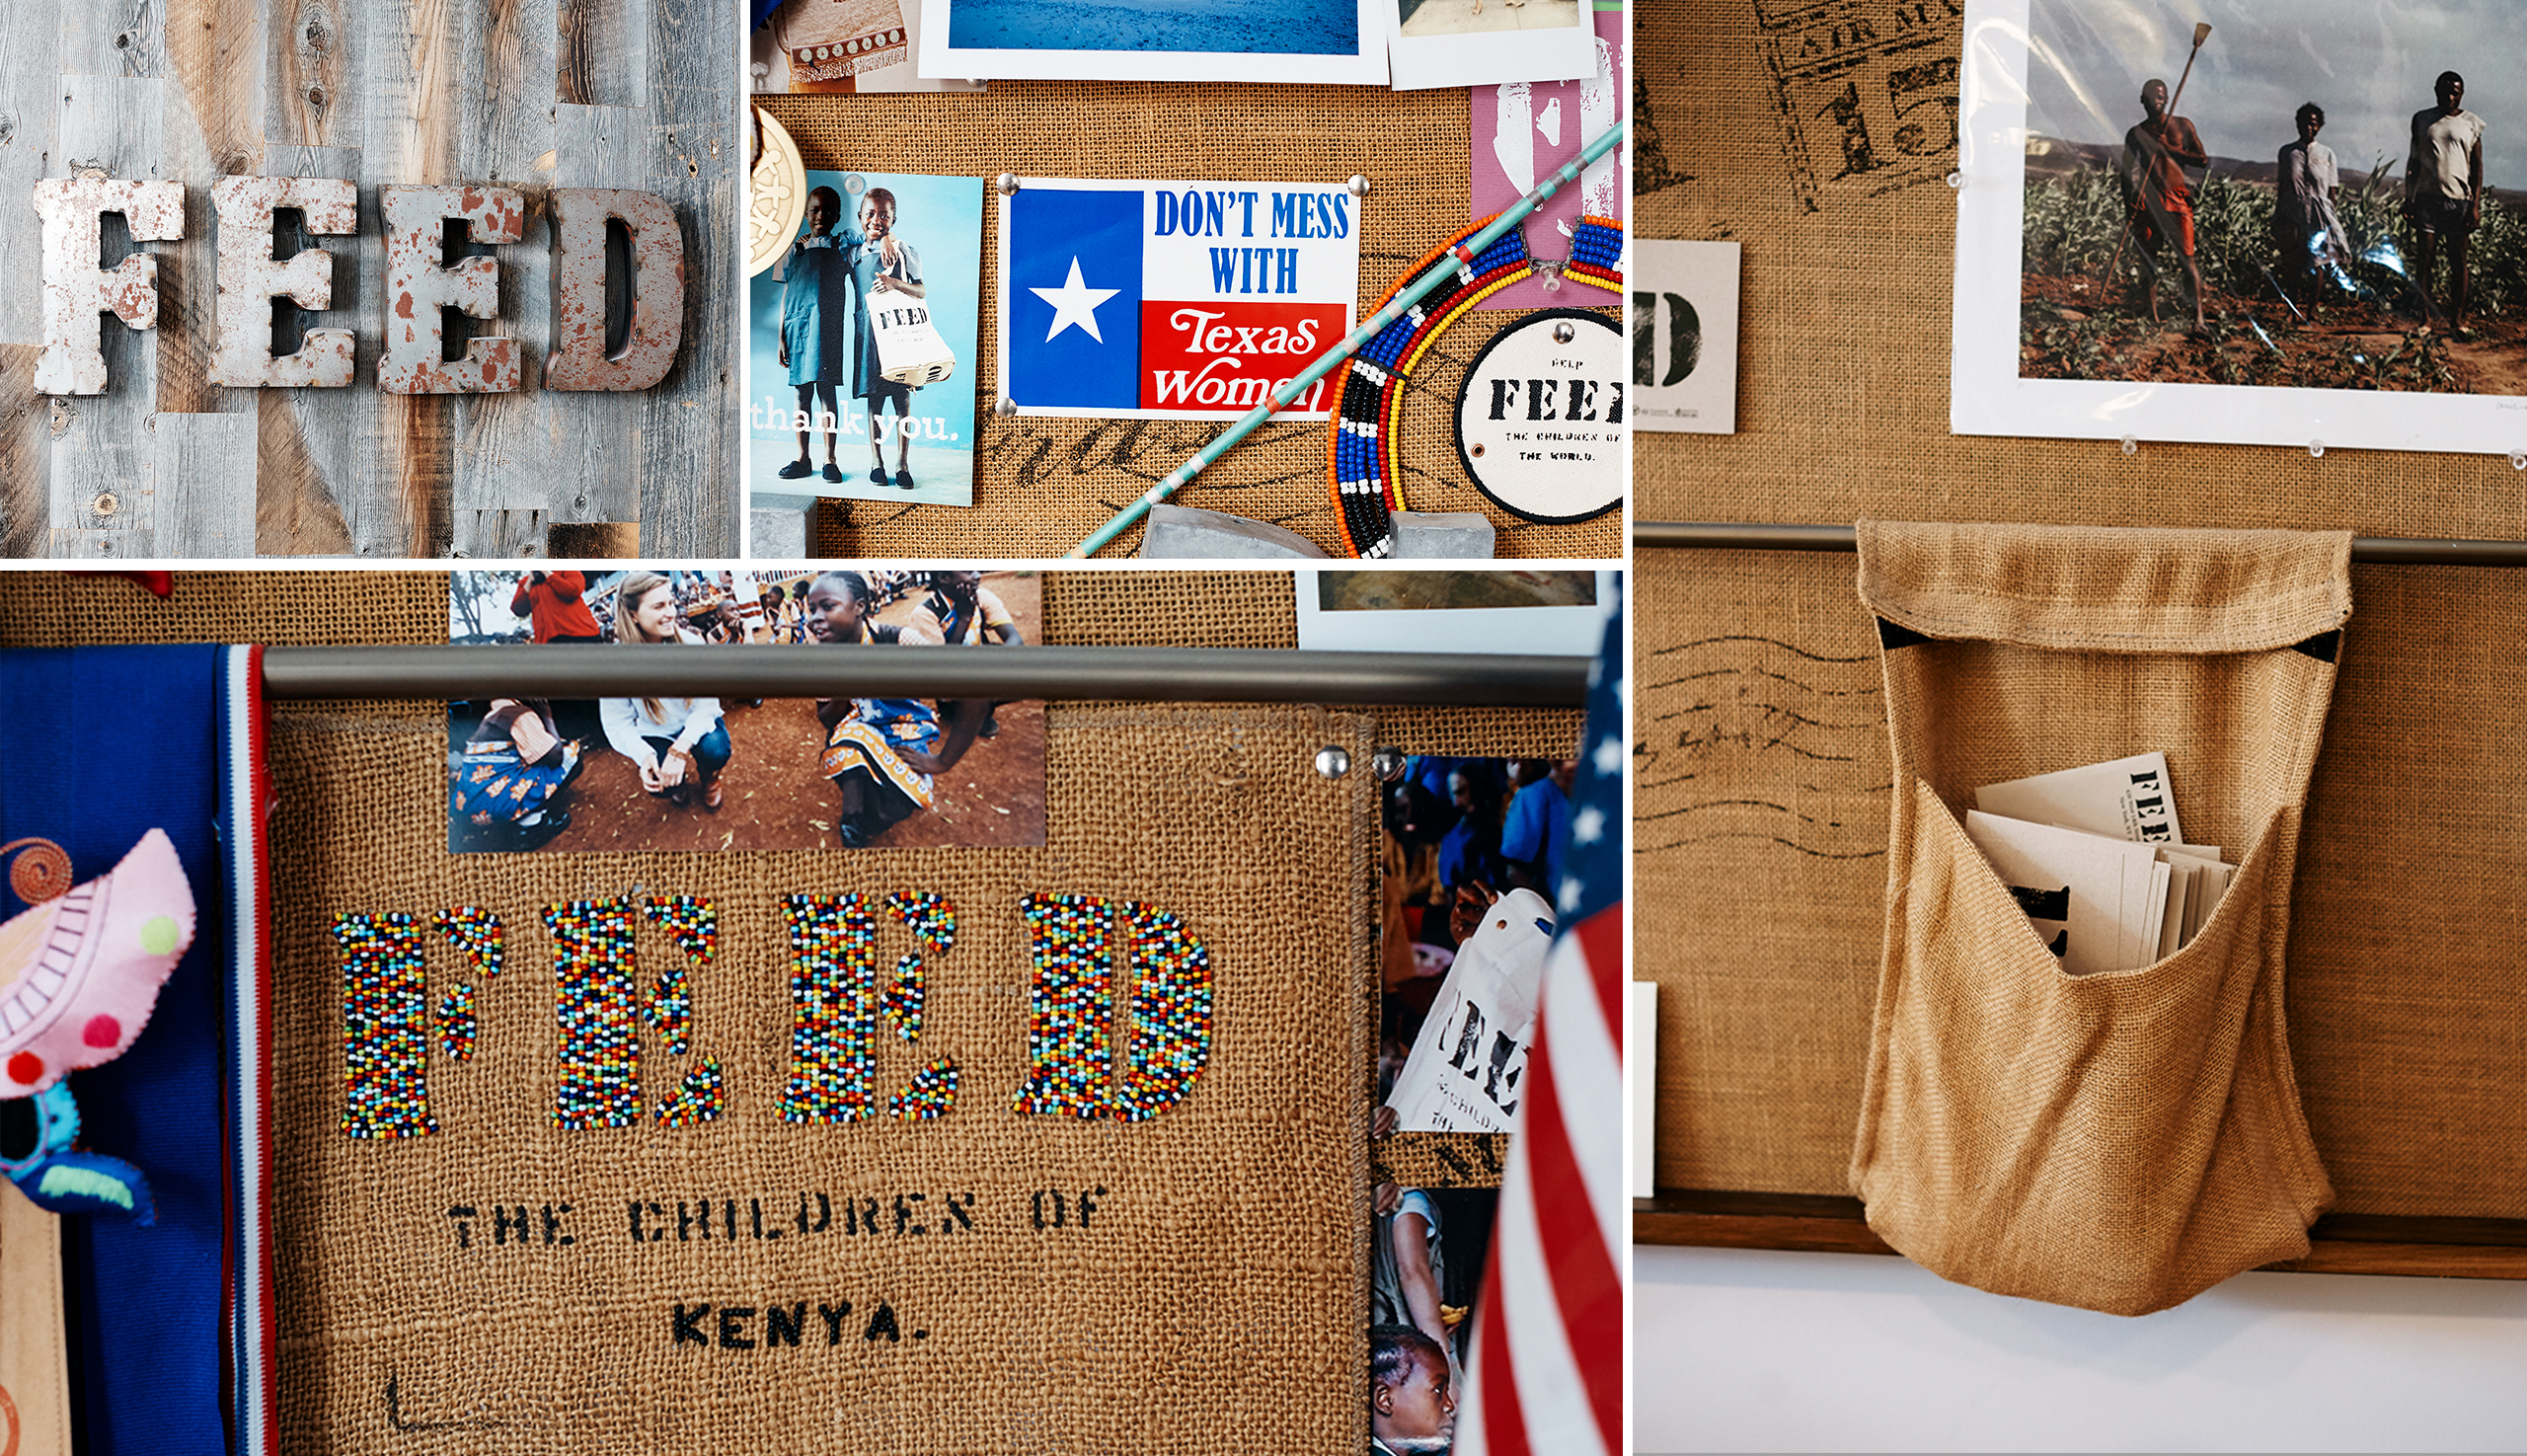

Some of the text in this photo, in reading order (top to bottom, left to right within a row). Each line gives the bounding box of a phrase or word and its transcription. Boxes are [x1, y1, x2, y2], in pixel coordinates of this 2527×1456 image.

[1154, 190, 1349, 240] DON'T MESS
[34, 175, 687, 396] FEED
[1209, 247, 1300, 294] WITH
[879, 307, 928, 331] FEED
[1170, 308, 1321, 355] Texas
[750, 396, 960, 443] thank you.
[1505, 432, 1529, 442] THE
[1536, 432, 1598, 442] CHILDREN
[1519, 451, 1596, 462] THE WORLD.
[331, 891, 1214, 1139] FEED
[449, 1185, 1107, 1249] THE CHILDREN OF
[673, 1299, 926, 1348] KENYA.
